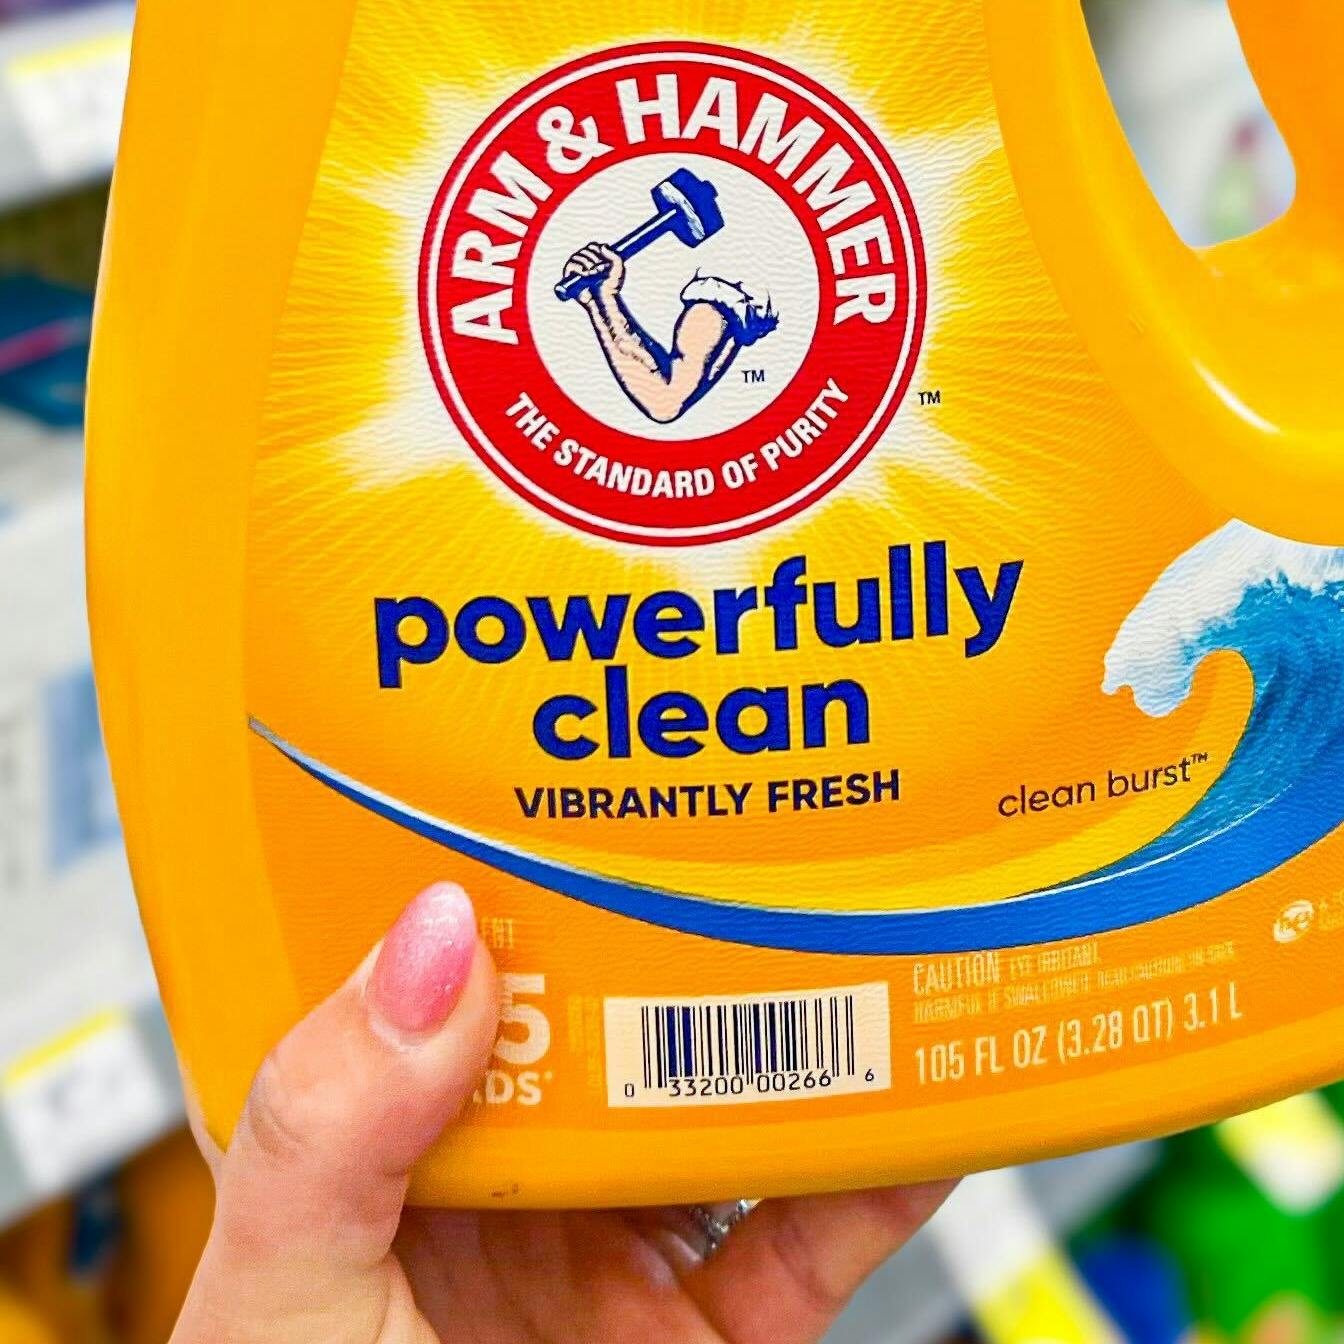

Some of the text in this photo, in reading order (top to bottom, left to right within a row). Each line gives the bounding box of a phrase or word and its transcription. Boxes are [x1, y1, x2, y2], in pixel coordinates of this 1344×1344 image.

[450, 73, 897, 346] ARM & HAMMER
[505, 377, 850, 498] THE STANDARD OF PURITY
[373, 540, 1024, 689] powerfully
[532, 665, 870, 761] clean
[513, 768, 901, 819] VIBRANTLY FRESH
[997, 780, 1096, 818] clean
[912, 950, 1001, 995] CAUTION
[914, 981, 1243, 1085] 105 FL OZ (3.28 QT) 3.1 L
[624, 1067, 875, 1098] 0 33200 00266 6
